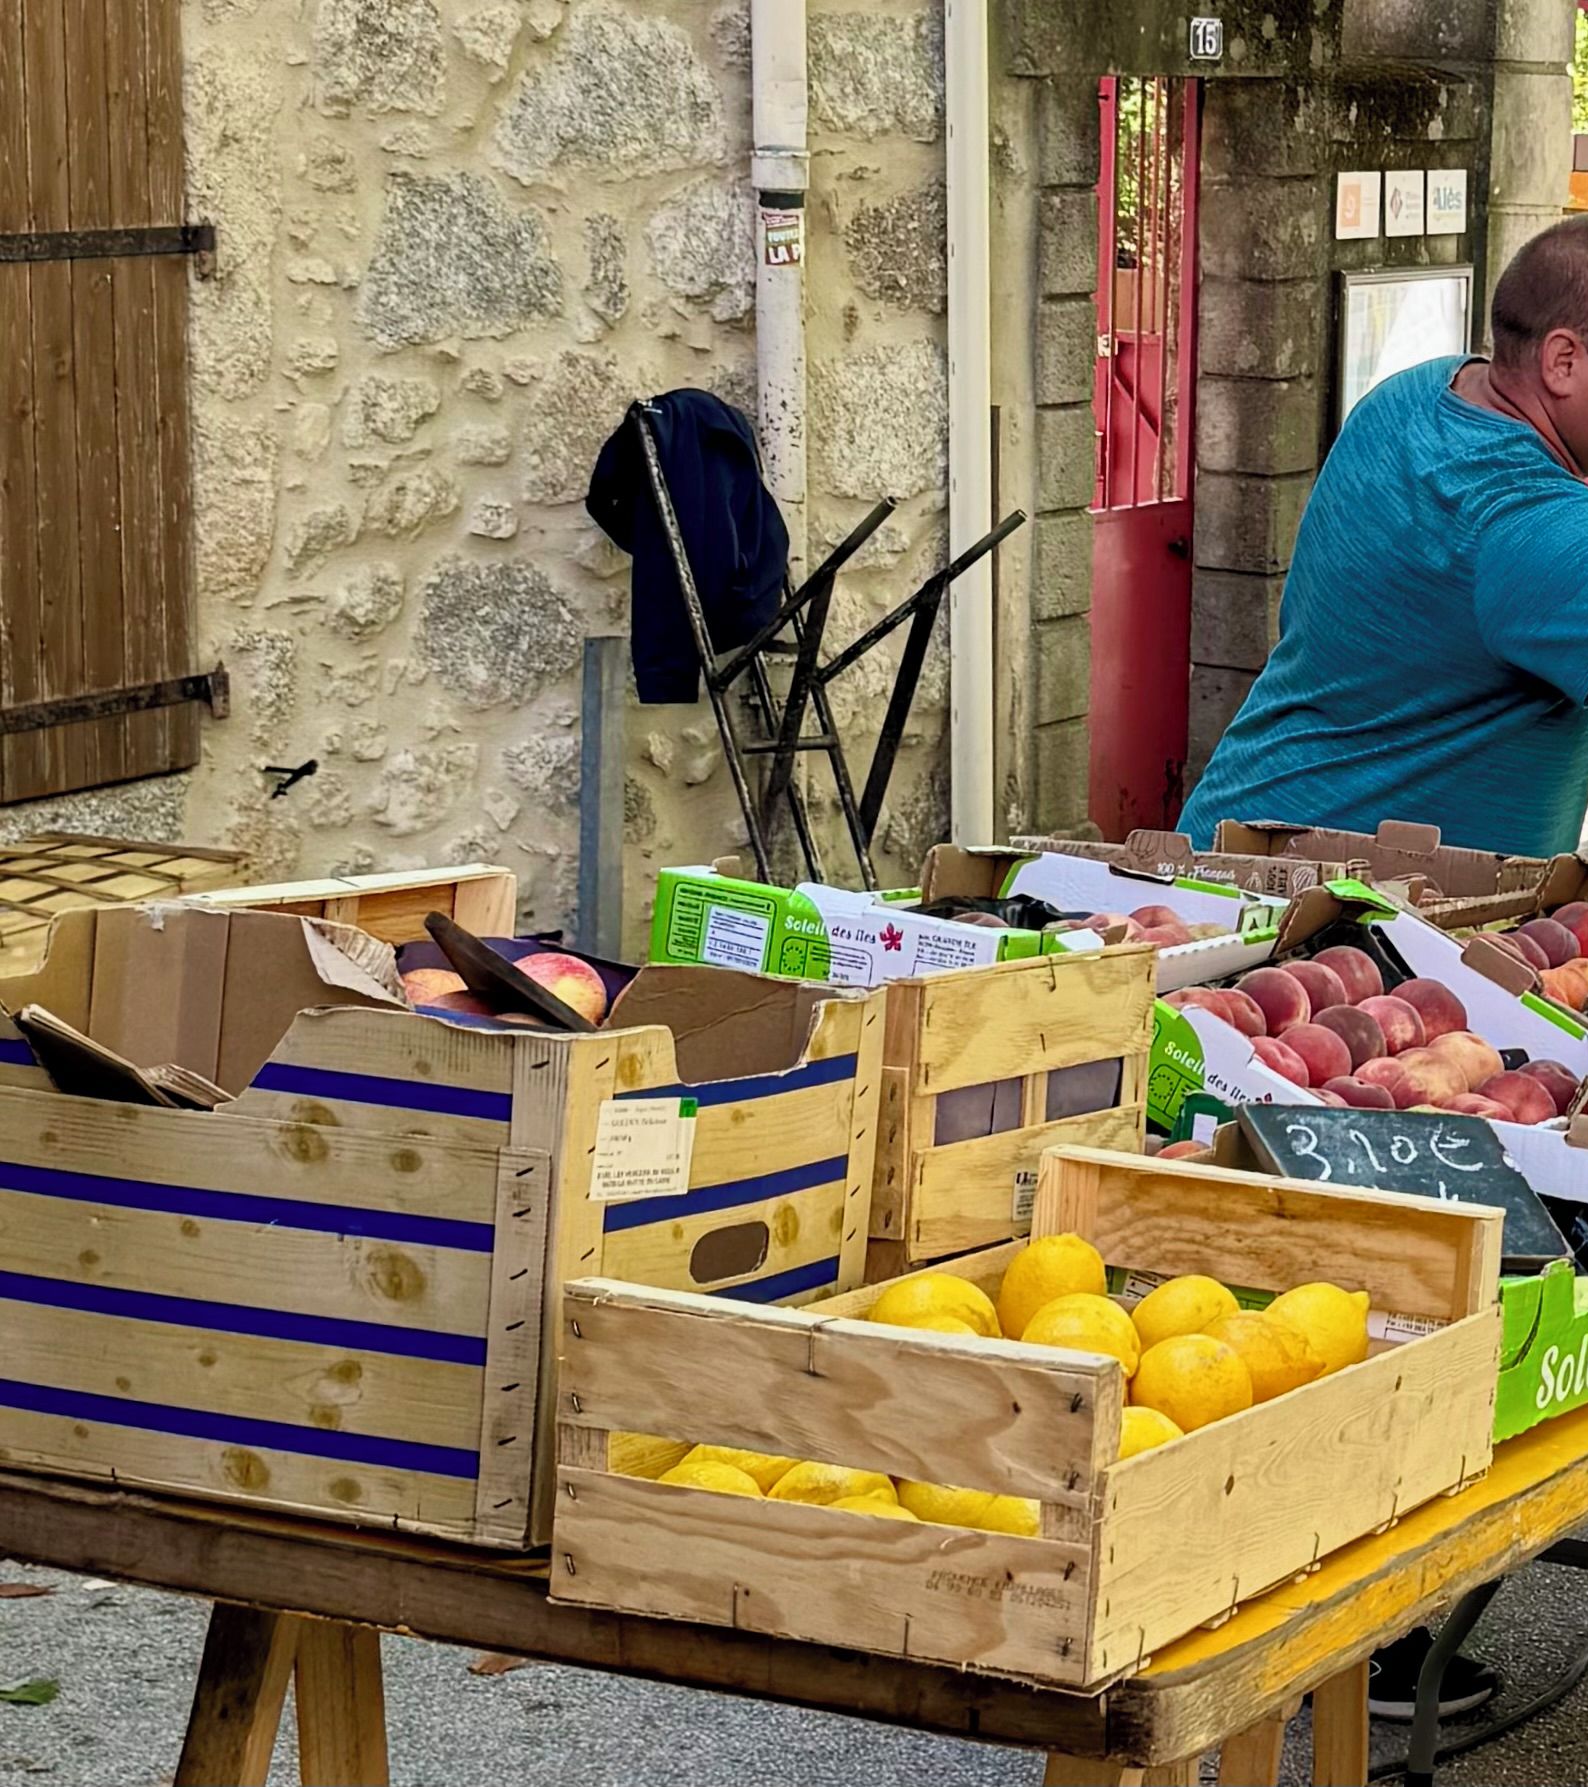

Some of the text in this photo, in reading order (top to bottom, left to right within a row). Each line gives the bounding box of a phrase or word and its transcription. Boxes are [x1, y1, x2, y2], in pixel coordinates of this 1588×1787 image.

[784, 914, 825, 936] Soleil
[831, 925, 852, 940] des
[1164, 1040, 1205, 1075] Soleil
[1207, 1073, 1228, 1092] des
